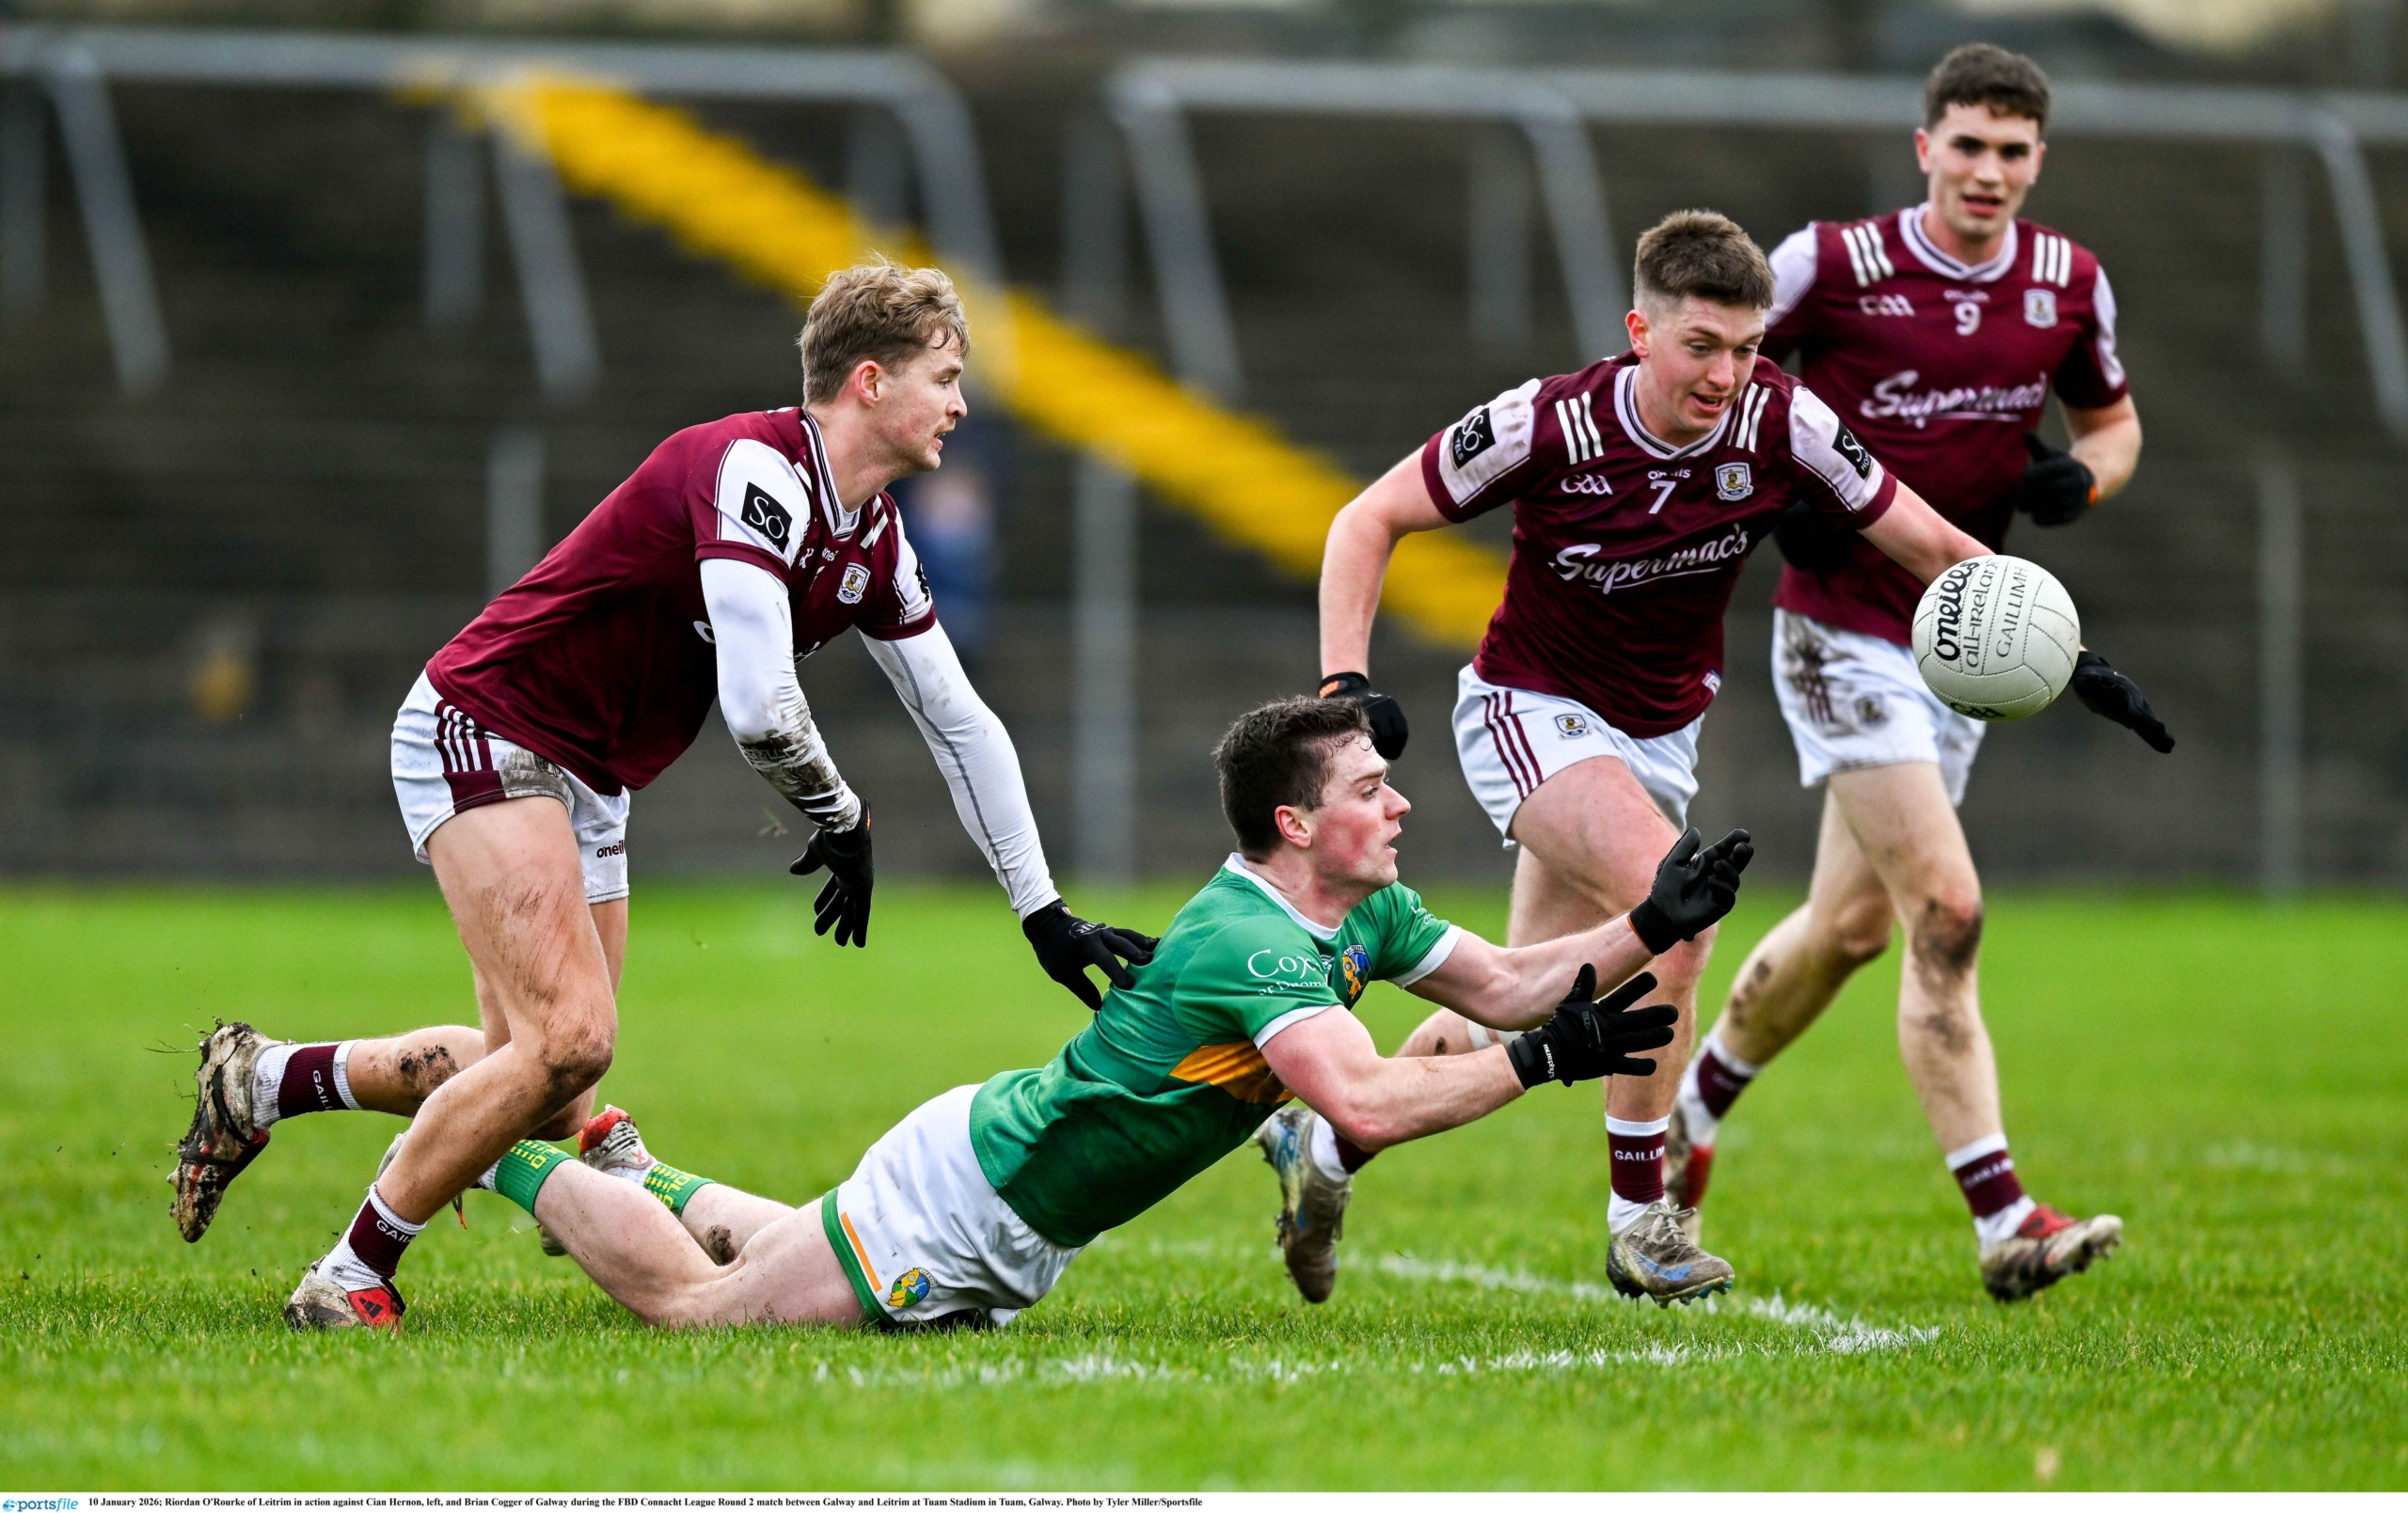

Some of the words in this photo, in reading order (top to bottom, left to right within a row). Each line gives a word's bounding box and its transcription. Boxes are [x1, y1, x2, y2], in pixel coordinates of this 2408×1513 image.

[1954, 302, 1981, 336] 9
[1648, 480, 1676, 514] 7
[1547, 522, 1748, 595] Supermac's
[1996, 566, 2027, 657] GAILLIMH
